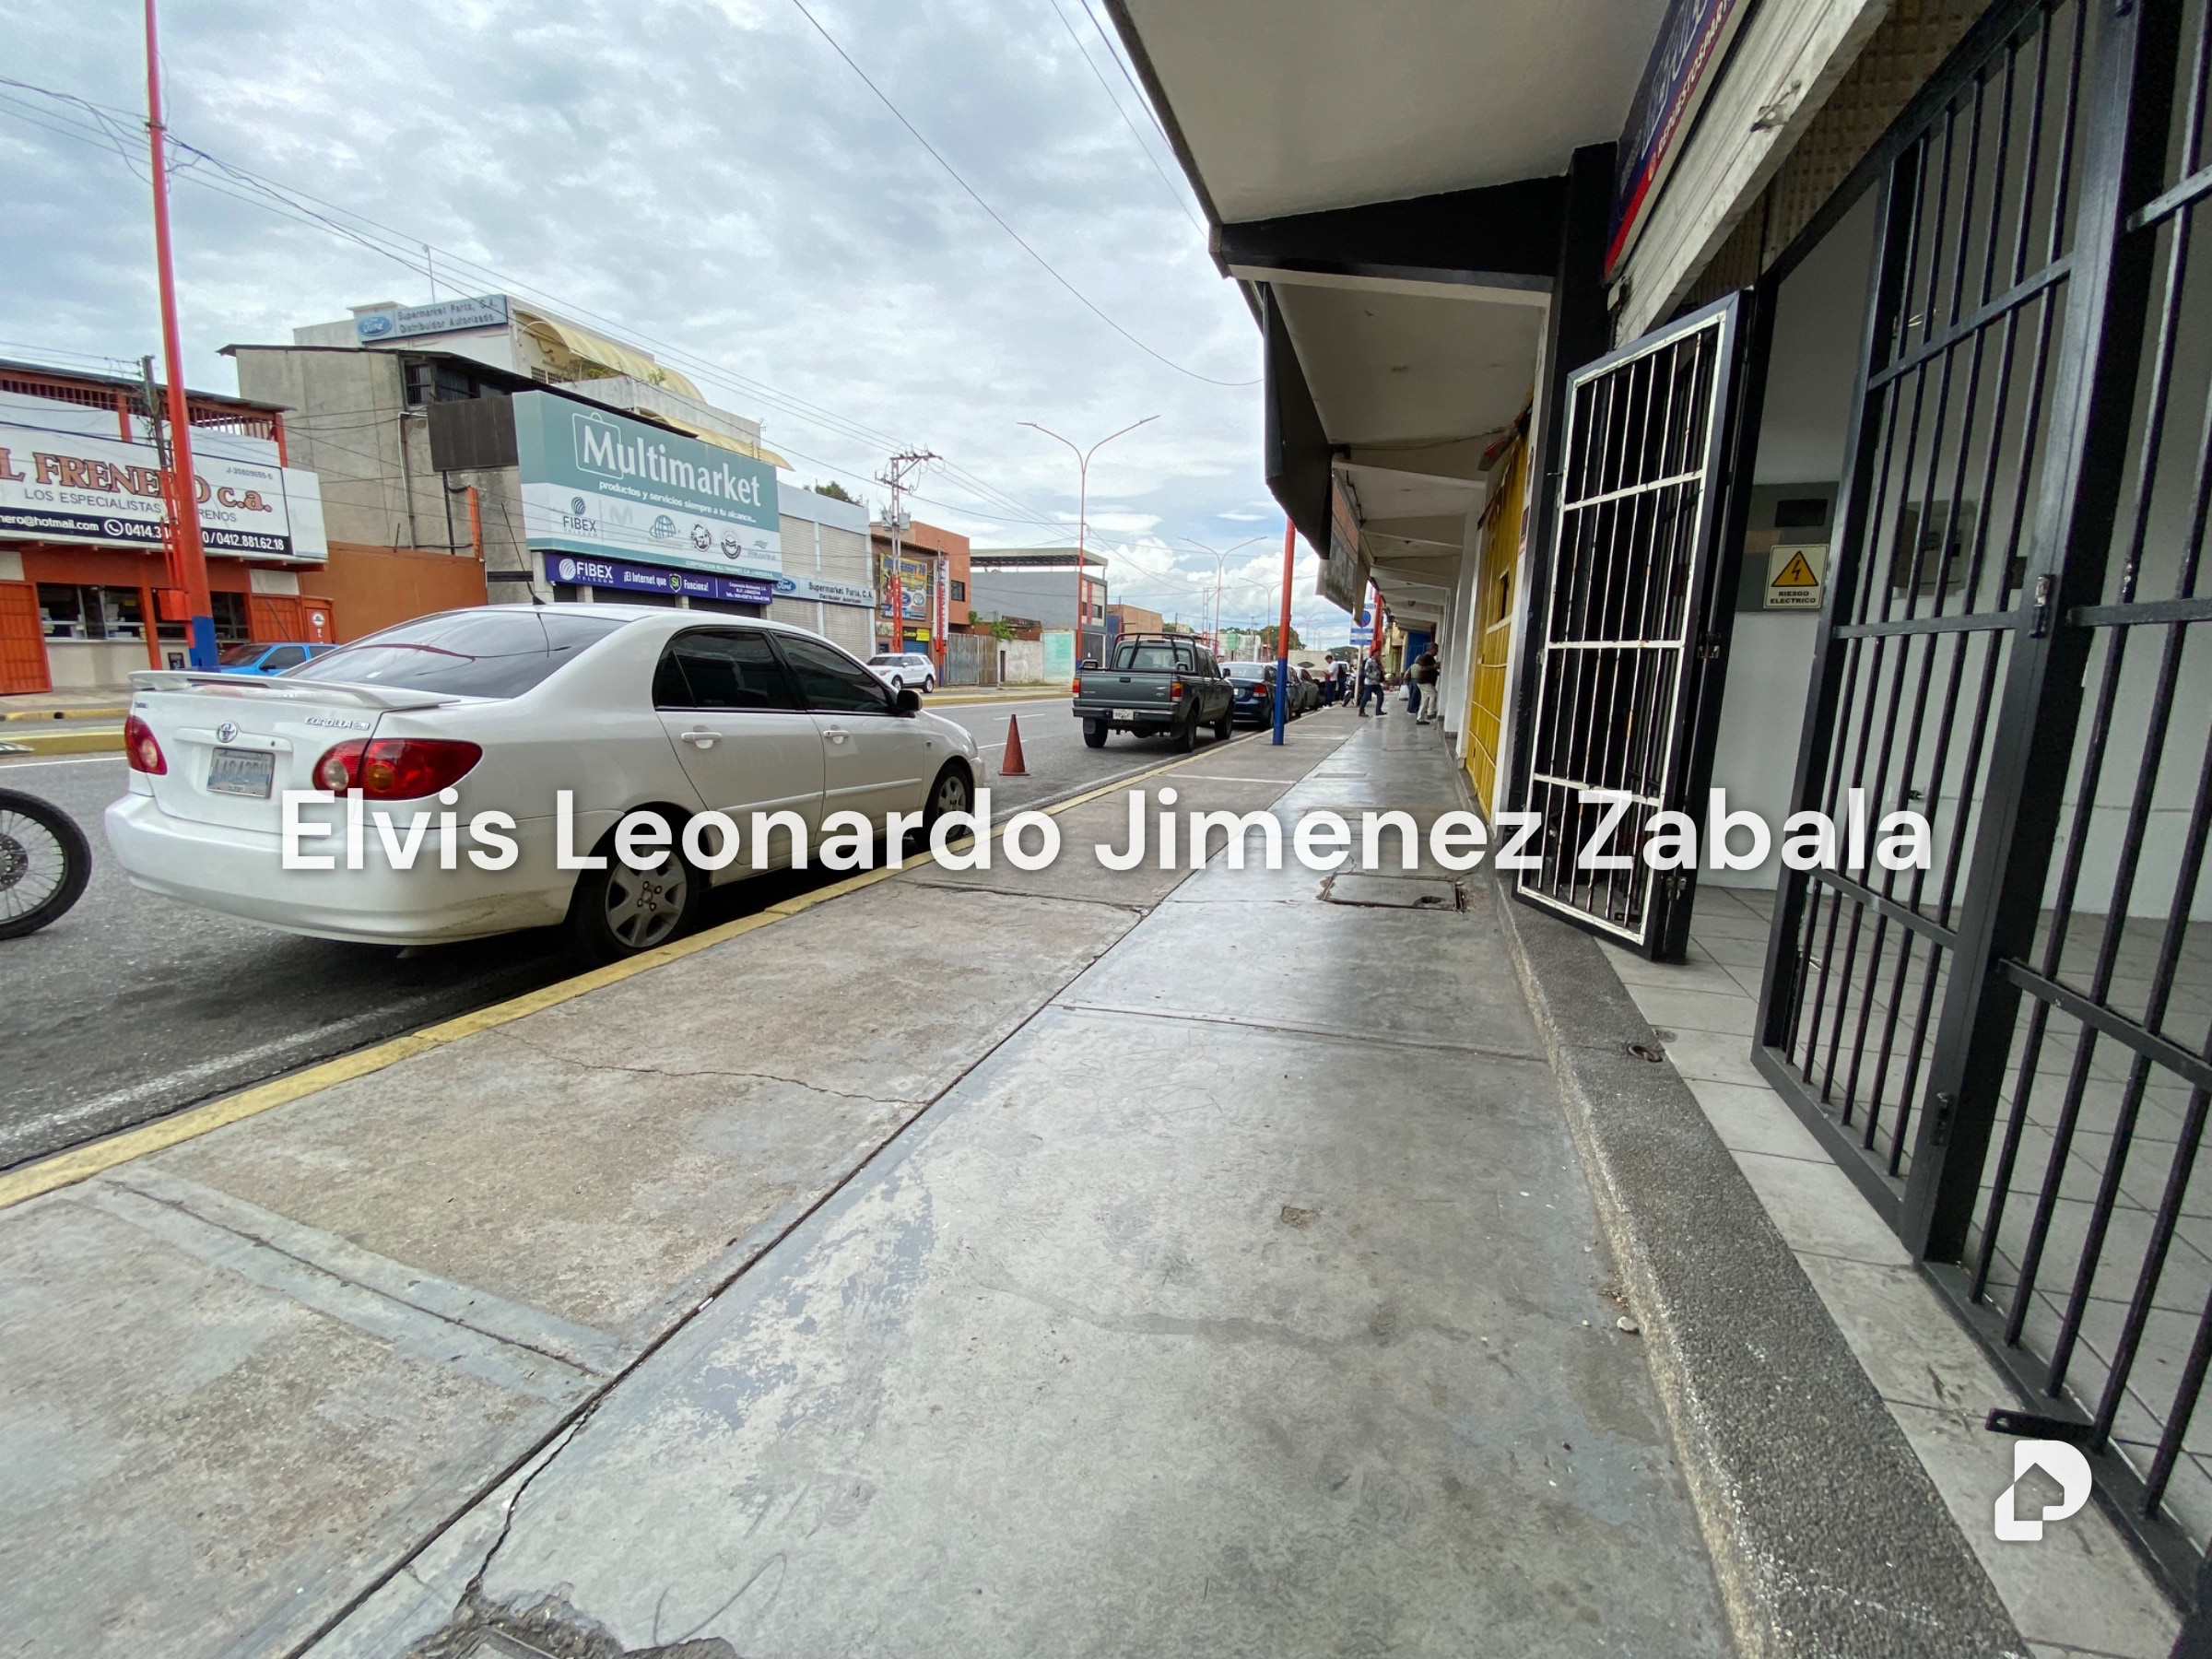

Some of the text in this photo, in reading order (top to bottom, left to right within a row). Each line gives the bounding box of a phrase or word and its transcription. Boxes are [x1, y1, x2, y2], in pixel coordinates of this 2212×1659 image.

[397, 307, 447, 321] Supermarket
[399, 312, 494, 334] Distribuidor Autorizado
[583, 425, 761, 507] Multimarket
[24, 488, 238, 523] LOS ESPECIALISTAS RENOS
[217, 487, 273, 513] c.a.
[598, 480, 641, 498] productos
[641, 490, 649, 500] y
[649, 491, 683, 508] servicios
[684, 500, 712, 513] siempre
[719, 507, 727, 516] tu
[562, 516, 597, 533] FIBEX
[576, 561, 614, 579] FIBEX
[577, 575, 615, 583] TELECOM
[632, 572, 655, 585] Internet
[655, 577, 667, 587] que
[776, 581, 792, 590] Ford
[809, 582, 845, 594] Supermarket
[305, 717, 351, 728] COROLLA
